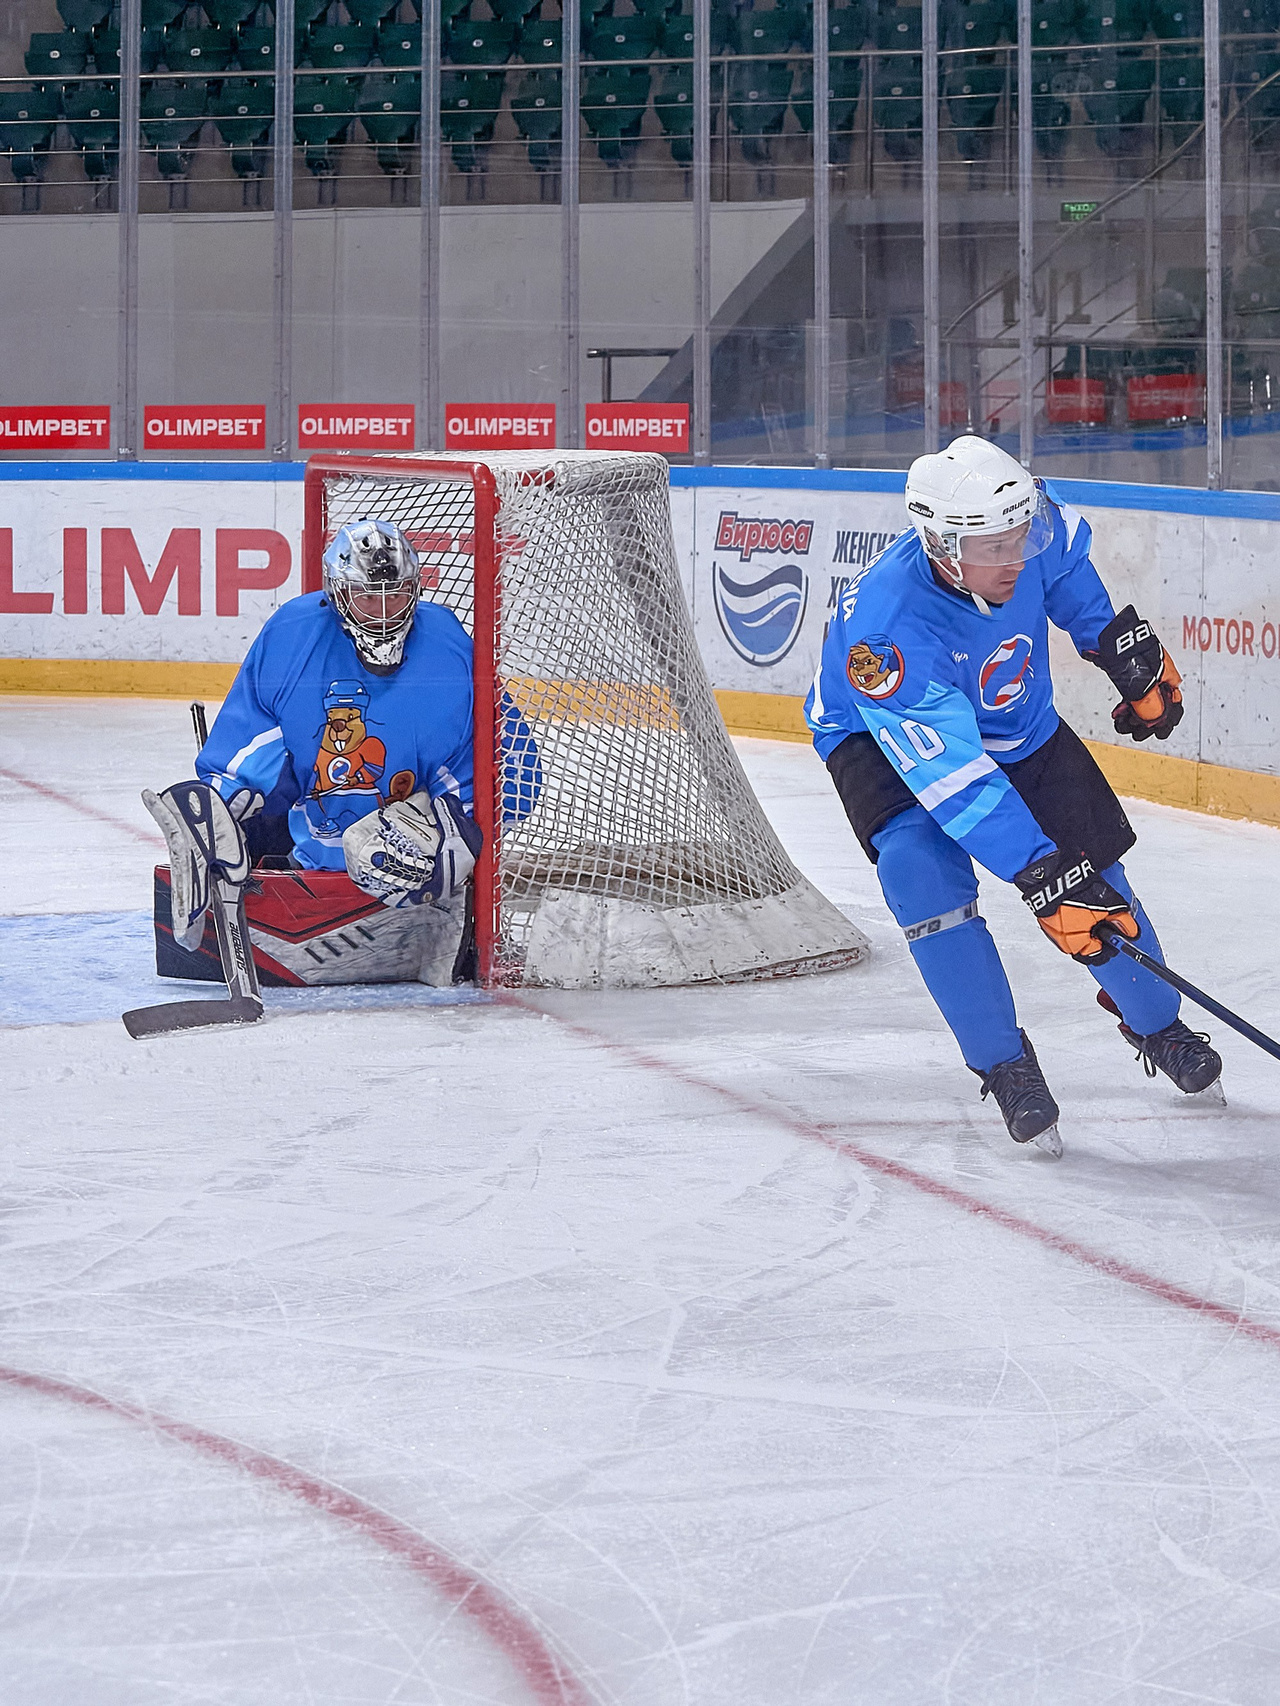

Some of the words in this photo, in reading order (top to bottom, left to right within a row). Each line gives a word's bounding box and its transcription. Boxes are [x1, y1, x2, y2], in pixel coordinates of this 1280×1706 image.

[0, 419, 107, 437] LIMPBET
[146, 418, 264, 437] OLIMPBET
[301, 417, 412, 437] OLIMPBET
[447, 417, 554, 437] OLIMPBET
[587, 417, 687, 438] OLIMPBET
[715, 513, 813, 560] Бирюса
[1183, 615, 1255, 657] MOTOR
[878, 718, 947, 774] 10
[229, 921, 248, 975] SUPREME
